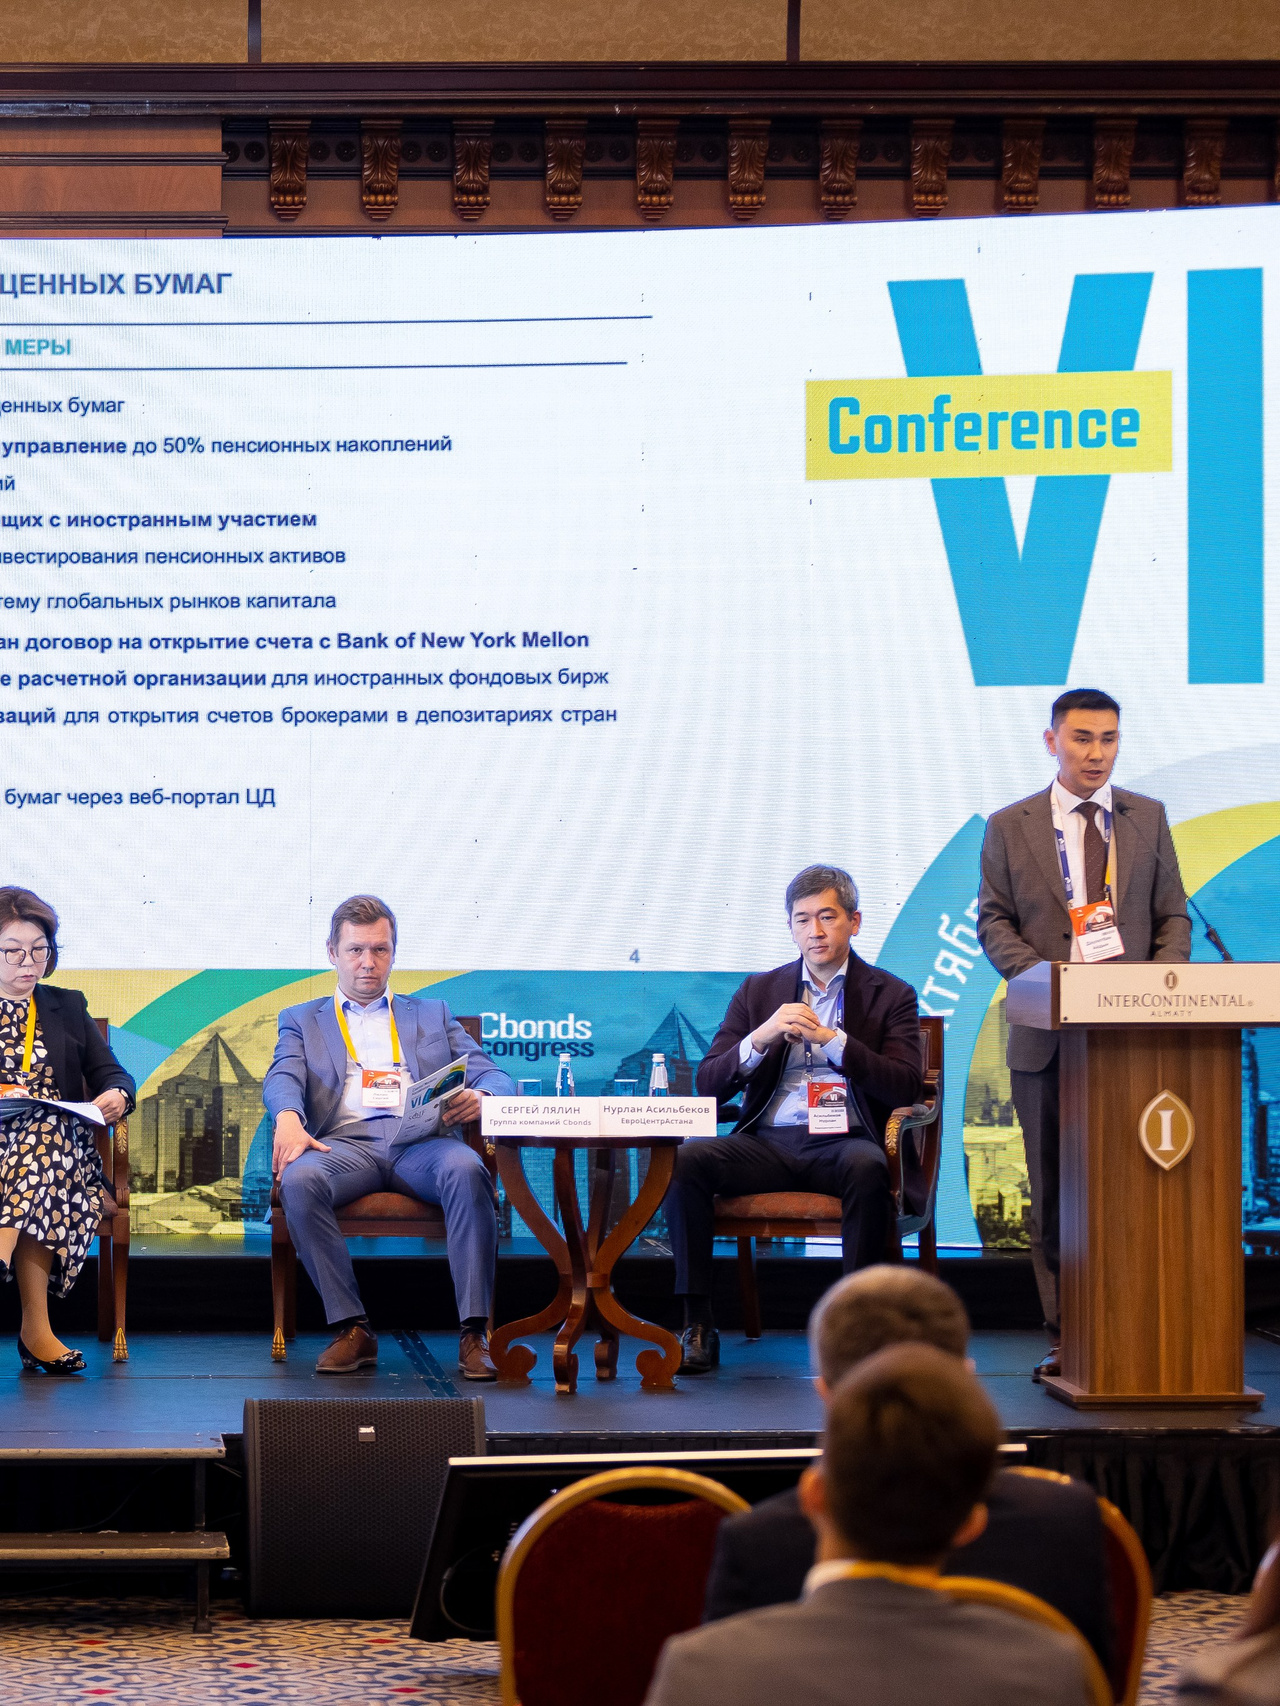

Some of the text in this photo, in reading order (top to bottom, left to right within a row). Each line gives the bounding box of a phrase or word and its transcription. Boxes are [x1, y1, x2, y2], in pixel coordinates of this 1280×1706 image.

[0, 273, 126, 299] ЦЕННЫХ
[134, 272, 233, 295] БУМАГ
[4, 338, 72, 356] МЕРЫ
[68, 396, 126, 418] бумаг
[828, 394, 1140, 455] Conference
[1, 441, 127, 459] управление
[132, 441, 158, 456] до
[163, 436, 205, 454] 50%
[211, 440, 331, 454] пенсионных
[336, 435, 452, 453] накоплений
[887, 267, 1265, 686] VI
[49, 515, 61, 528] с
[67, 514, 212, 532] иностранным
[217, 514, 317, 532] участием
[144, 551, 265, 565] пенсионных
[269, 550, 346, 564] активов
[46, 592, 164, 610] глобальных
[169, 596, 241, 613] рынков
[247, 595, 337, 609] капитала
[24, 637, 113, 654] договор
[118, 637, 143, 650] на
[149, 636, 250, 654] открытие
[255, 636, 314, 650] счета
[318, 636, 331, 650] с
[336, 632, 389, 650] Bank
[395, 631, 417, 649] of
[421, 632, 466, 649] New
[469, 631, 517, 649] York
[522, 630, 589, 648] Mellon
[18, 669, 127, 691] расчетной
[133, 673, 267, 690] организации
[270, 673, 308, 689] для
[314, 672, 444, 690] иностранных
[448, 668, 552, 690] фондовых
[557, 667, 609, 689] бирж
[62, 710, 99, 726] для
[107, 710, 199, 727] открытия
[207, 710, 274, 724] счетов
[281, 706, 388, 727] брокерами
[396, 710, 408, 723] в
[414, 709, 553, 726] депозитариях
[560, 709, 617, 726] стран
[4, 788, 62, 810] бумаг
[66, 792, 124, 809] через
[129, 787, 240, 809] веб-портал
[246, 788, 276, 809] ЦД
[629, 949, 641, 964] 4
[480, 1012, 593, 1039] Cbonds
[481, 1040, 595, 1061] congress
[501, 1104, 581, 1114] СЕРГЕЙ ЛЯЛИН
[603, 1105, 710, 1115] Нурлан Асильбеков
